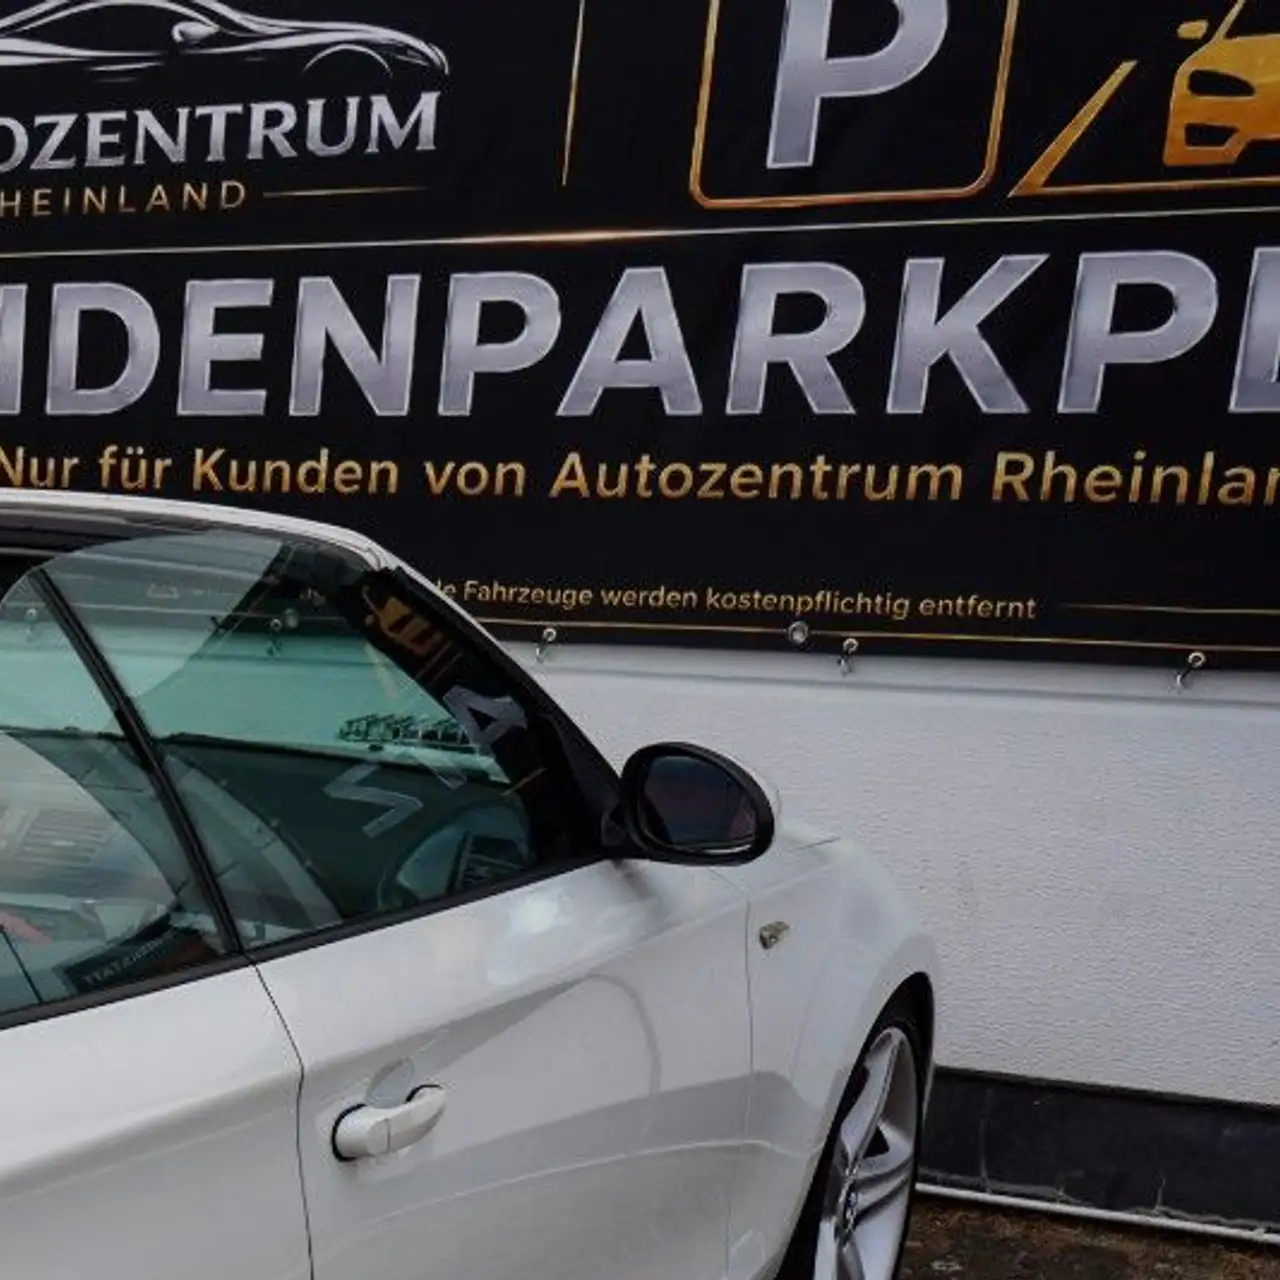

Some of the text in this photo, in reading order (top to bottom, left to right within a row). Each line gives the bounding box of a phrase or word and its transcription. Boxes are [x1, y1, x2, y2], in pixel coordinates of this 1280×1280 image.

[766, 0, 951, 170] P
[99, 445, 173, 489] für
[191, 447, 400, 494] Kunden
[423, 460, 526, 497] von
[548, 450, 964, 500] Autozentrum
[463, 579, 593, 611] Fahrzeuge
[600, 585, 697, 609] werden
[706, 587, 910, 620] kostenpflichtig
[919, 594, 1037, 619] entfernt
